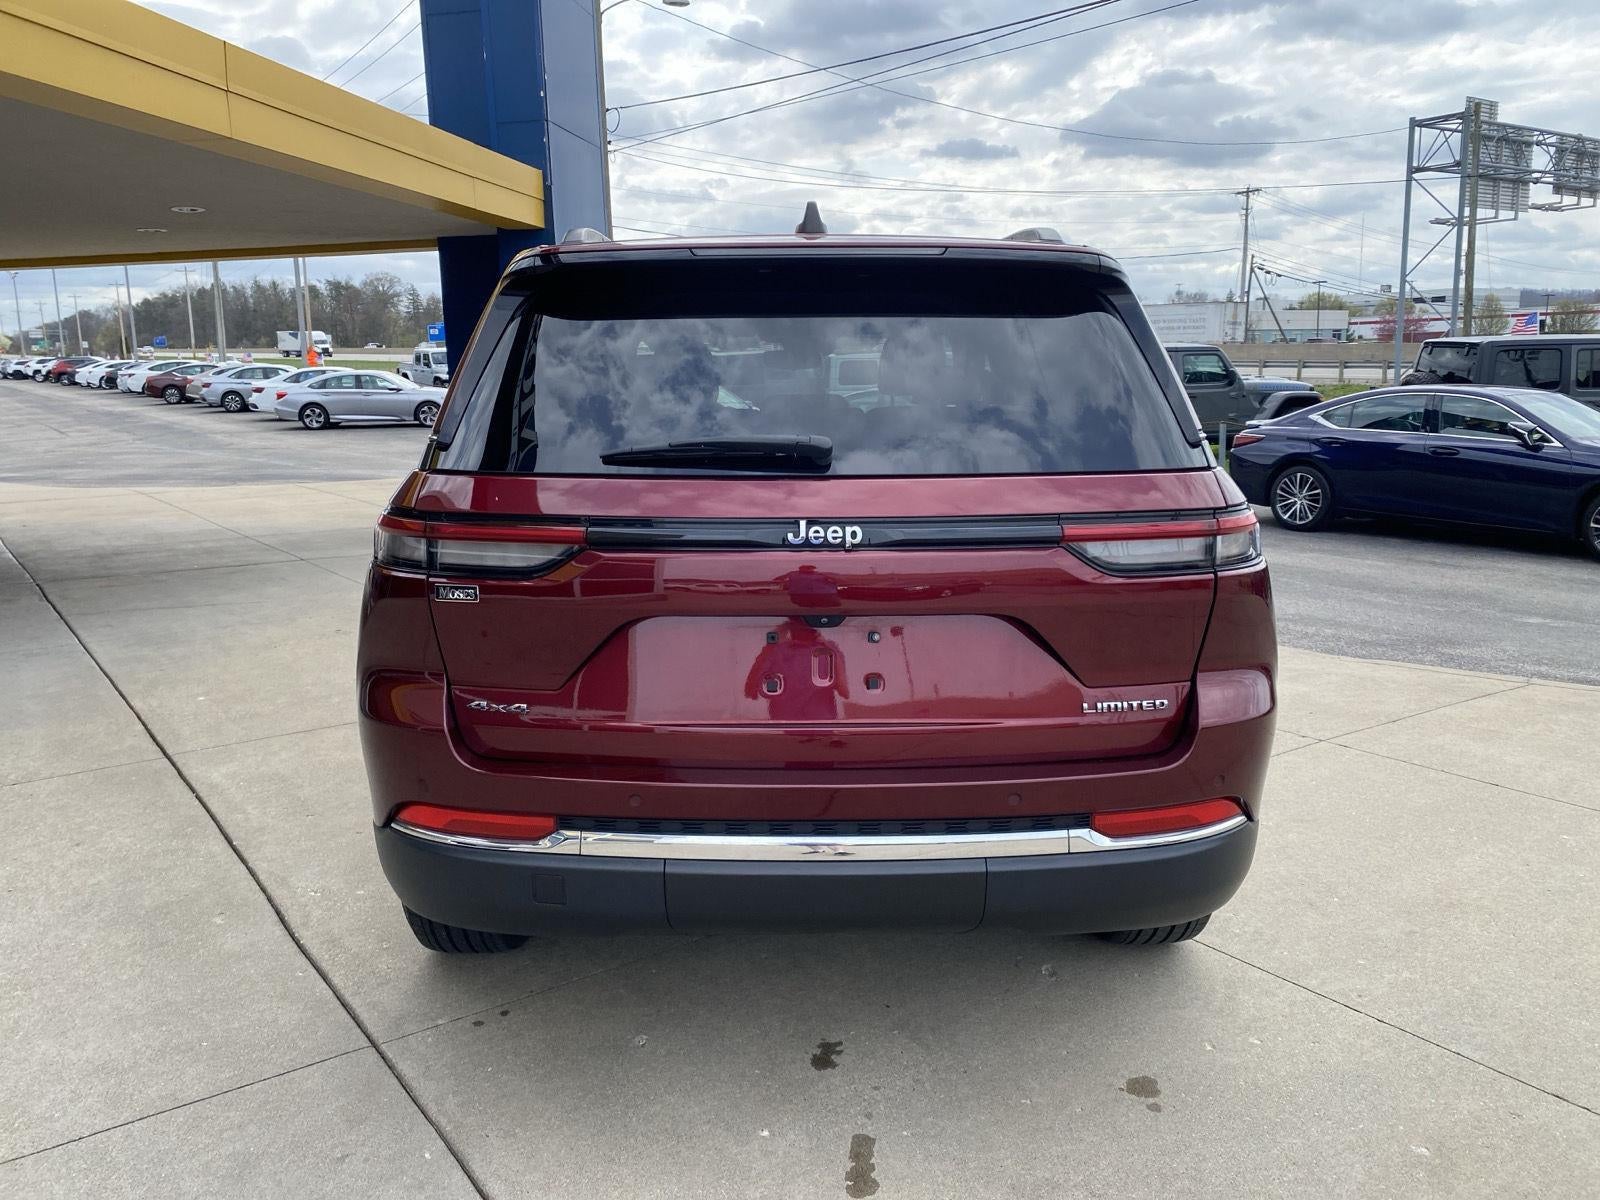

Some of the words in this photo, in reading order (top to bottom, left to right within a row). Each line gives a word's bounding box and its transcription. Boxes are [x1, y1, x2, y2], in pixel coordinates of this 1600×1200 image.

[787, 519, 863, 549] Jeep
[467, 700, 530, 714] 4x4
[1082, 699, 1169, 713] LIMITED
